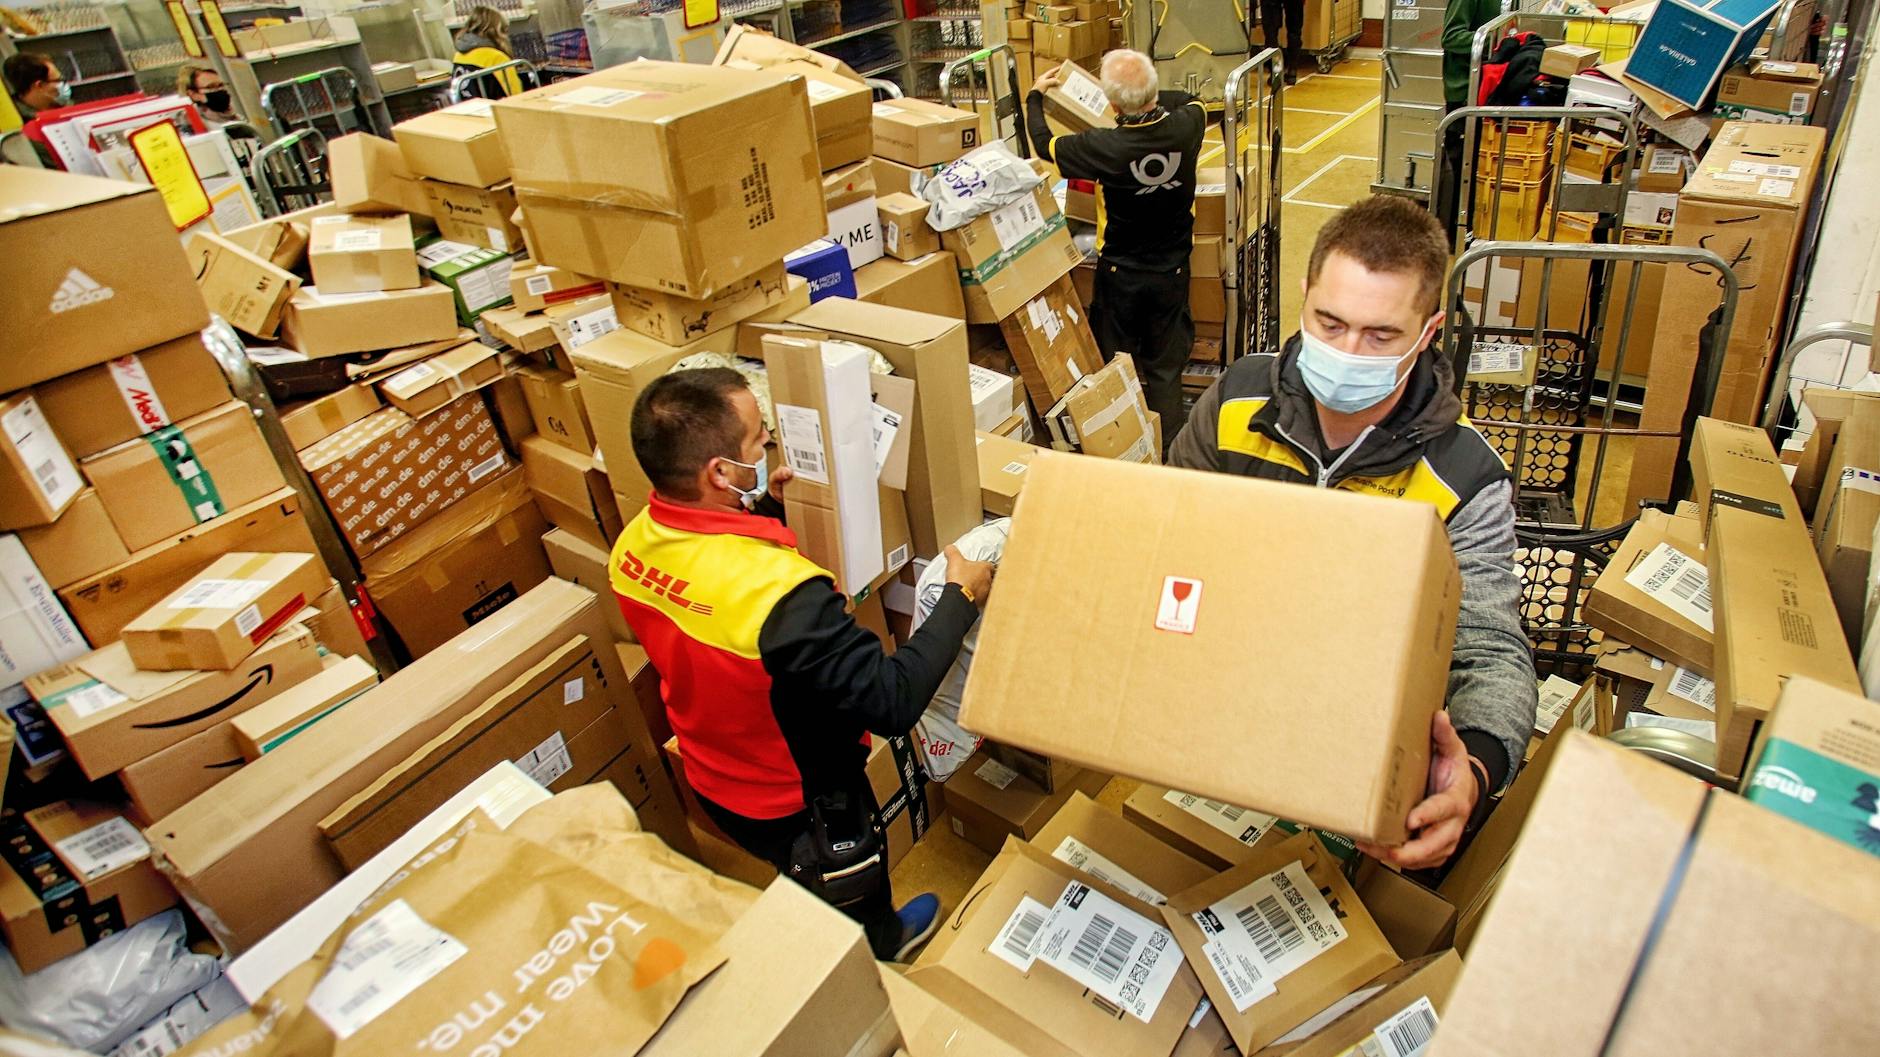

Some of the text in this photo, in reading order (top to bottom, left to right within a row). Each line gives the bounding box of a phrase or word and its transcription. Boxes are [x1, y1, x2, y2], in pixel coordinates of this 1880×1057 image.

[849, 223, 874, 247] ME
[423, 409, 452, 436] dm.de
[458, 418, 492, 452] dm.de
[362, 441, 392, 469] dm.de
[393, 438, 421, 464] dm.de
[418, 433, 451, 464] dm.de
[327, 470, 359, 499] dm.de
[360, 466, 389, 493] dm.de
[380, 467, 414, 499] dm.de
[418, 455, 453, 489] dm.de
[444, 458, 474, 487] dm.de
[409, 490, 440, 519] dm.de
[1378, 485, 1395, 495] Post
[280, 503, 296, 517] L
[375, 493, 413, 527] dm.de
[620, 550, 693, 609] DHL
[929, 740, 955, 756] da!
[1321, 829, 1356, 850] amazon
[1064, 884, 1080, 906] DHL
[544, 911, 647, 1002] Love
[416, 900, 620, 1051] Wear me.
